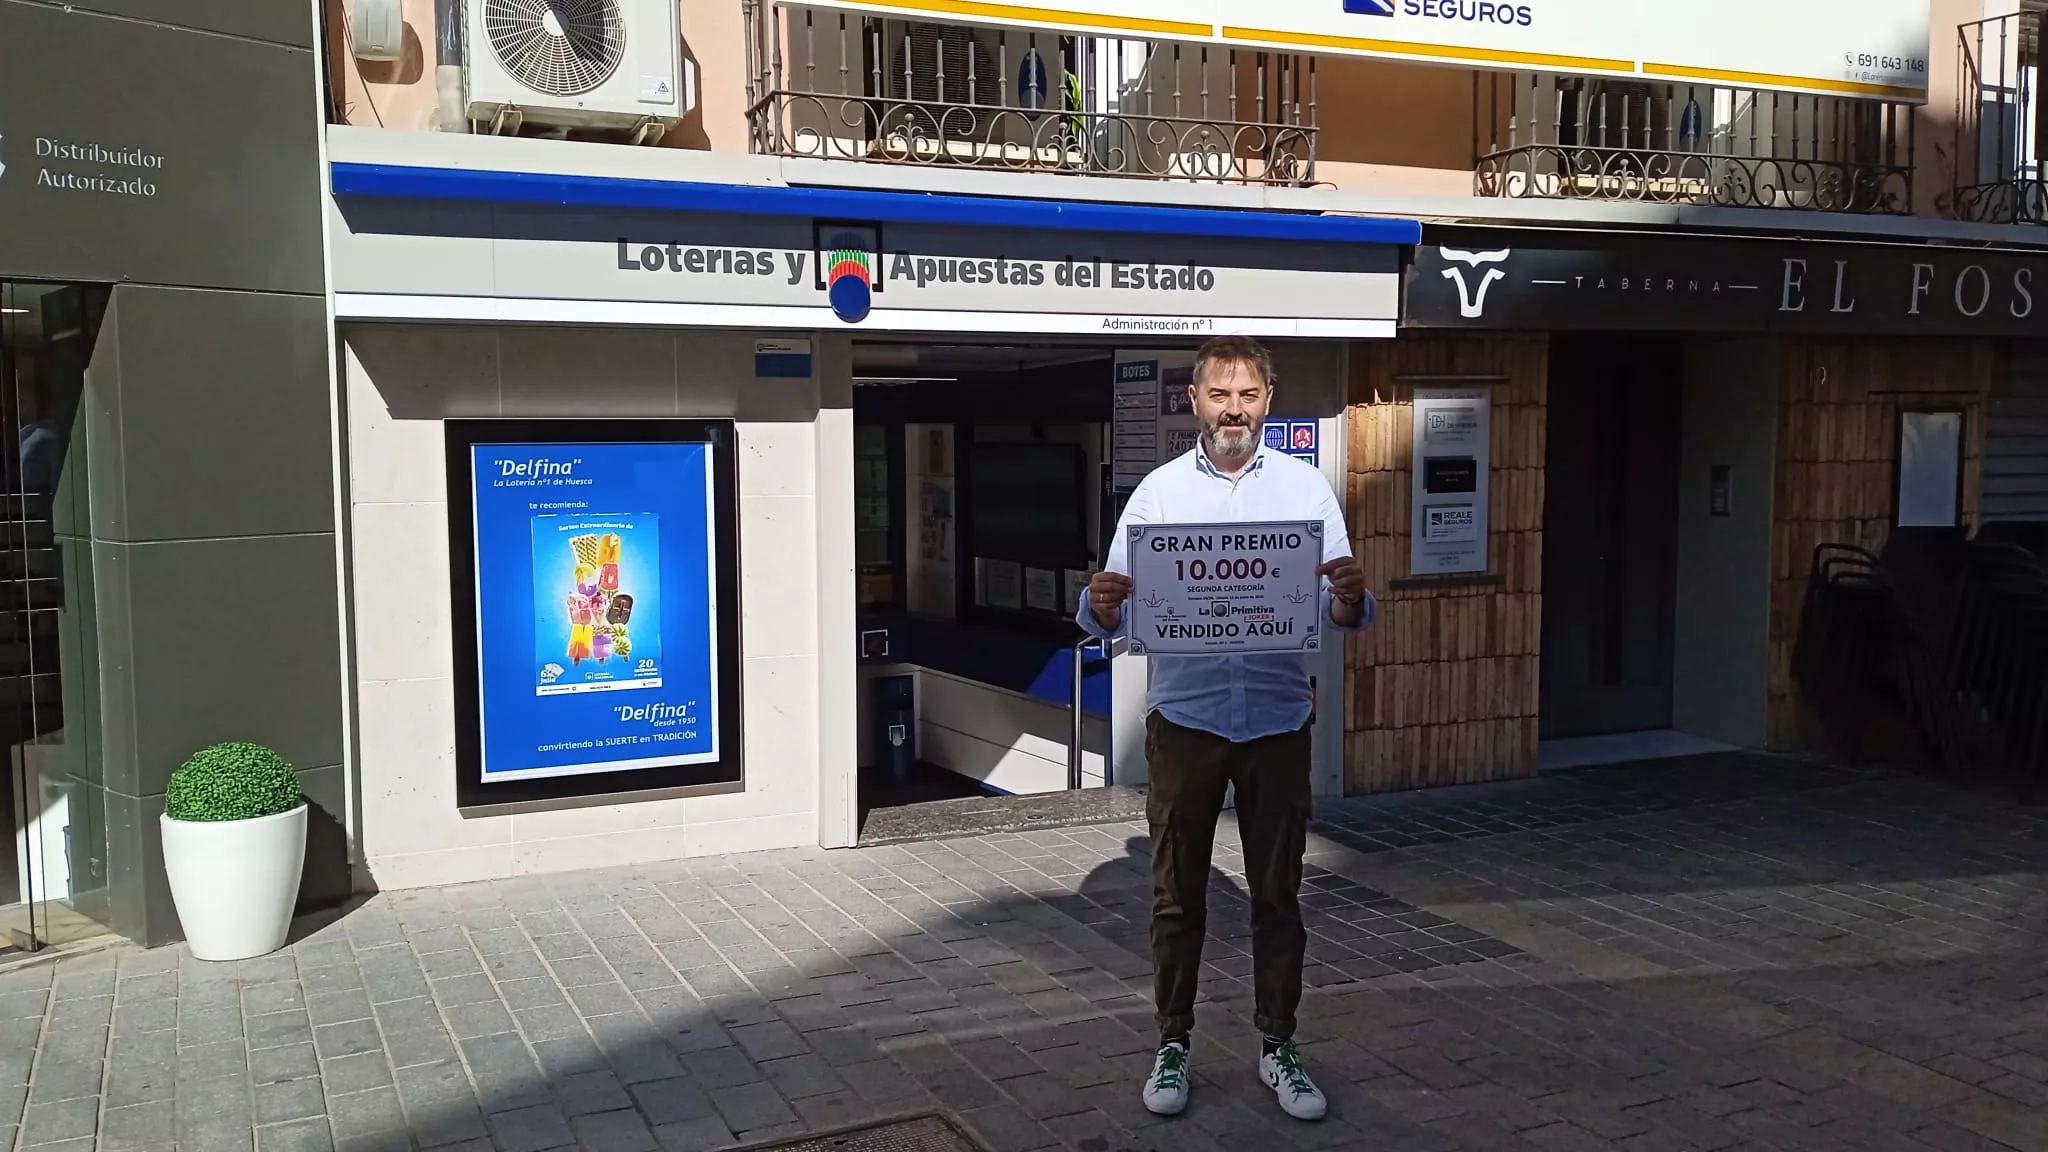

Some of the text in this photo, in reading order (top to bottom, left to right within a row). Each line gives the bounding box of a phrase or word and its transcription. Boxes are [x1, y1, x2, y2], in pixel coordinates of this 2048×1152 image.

[1404, 0, 1532, 26] SEGUROS
[1858, 53, 1924, 72] 691 643 148
[35, 137, 165, 168] Distribuidor
[37, 168, 156, 196] Autorizado
[787, 252, 806, 285] y
[889, 250, 1045, 288] Apuestas
[1055, 255, 1101, 288] del
[1111, 259, 1215, 291] Estado
[1575, 276, 1720, 292] TABERNA
[1778, 258, 2033, 318] EL FOS
[1101, 317, 1214, 331] Administración nº 1
[1122, 365, 1150, 378] BOTES
[494, 458, 582, 479] "Delfina"
[494, 479, 504, 487] La
[506, 478, 535, 487] Lotería
[553, 478, 563, 486] de
[565, 478, 593, 486] Huesca
[529, 500, 588, 510] te recomienda:
[1444, 511, 1473, 519] REALE
[1150, 533, 1301, 553] GRAN PREMIO
[1175, 557, 1281, 581] 10.000 €
[1186, 583, 1265, 593] SEGUNDA CATEGORÍA
[1199, 604, 1275, 616] La Primitiva
[1156, 617, 1294, 639] VENDIDO AQUÍ
[638, 659, 654, 668] 20
[614, 701, 696, 722] "Delfina"
[653, 716, 697, 728] desde 1950
[538, 739, 593, 752] convirtiendo
[596, 738, 603, 747] la
[605, 735, 638, 746] SUERTE
[652, 730, 697, 742] TRADICIÓN
